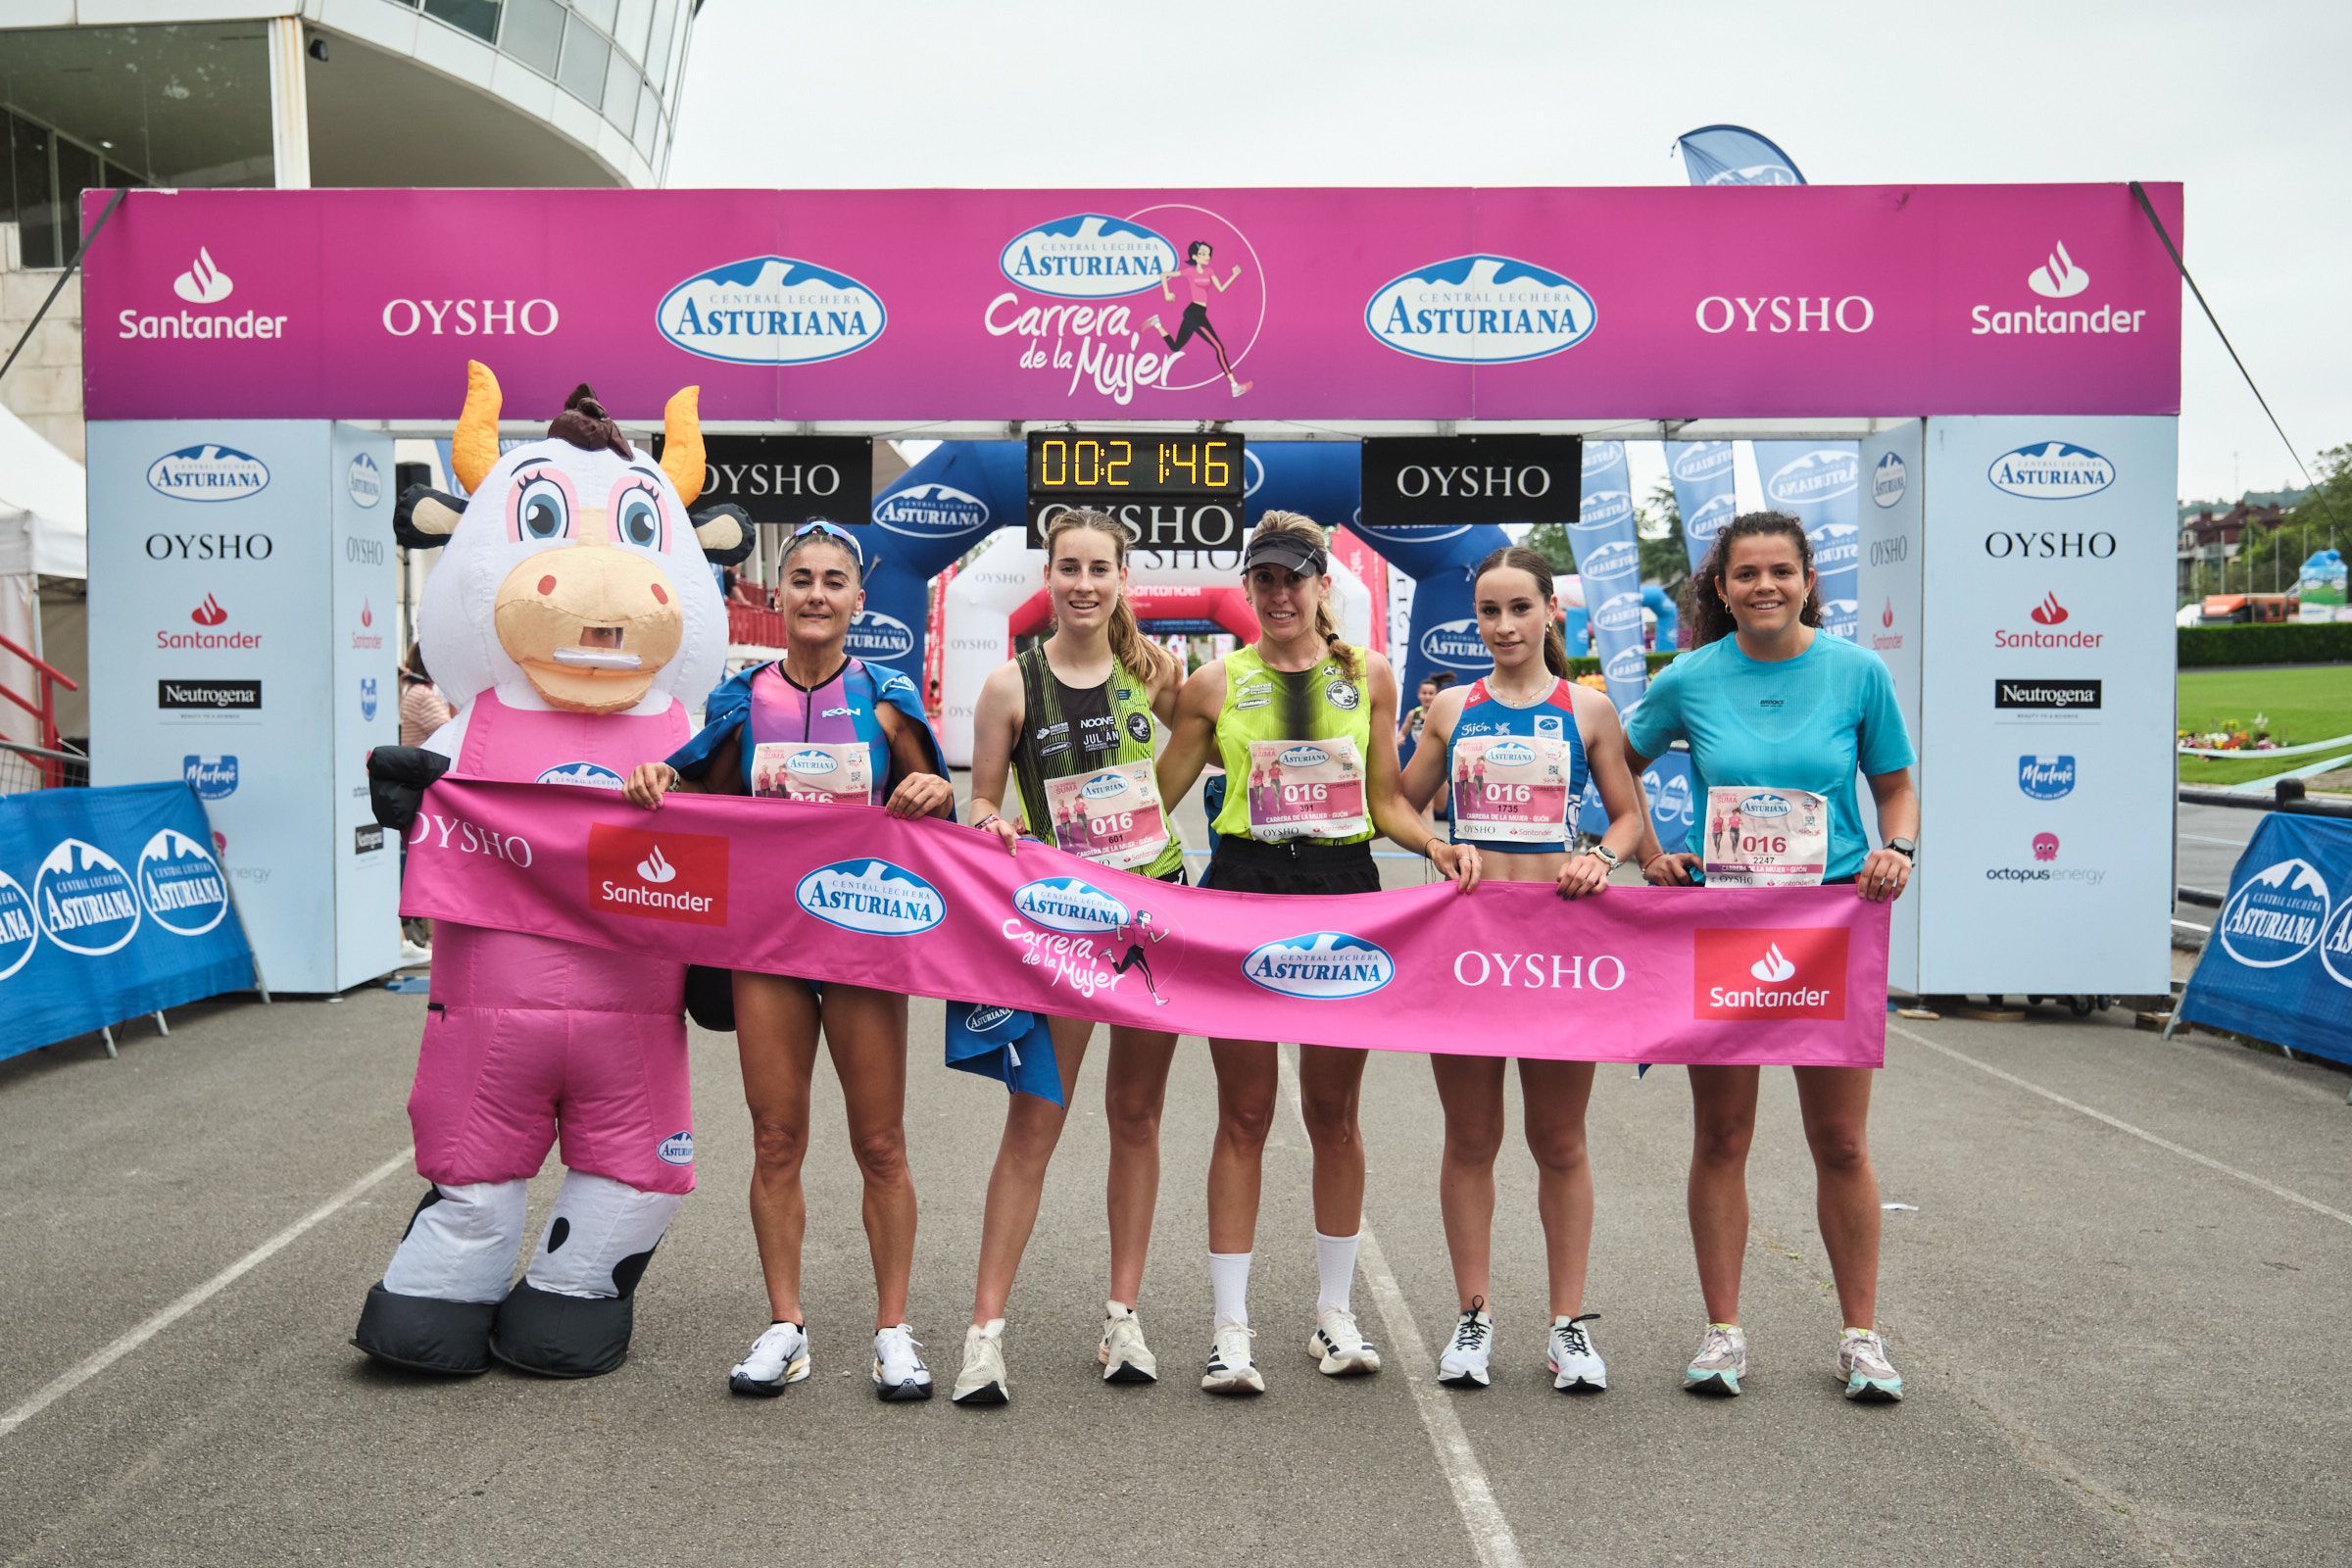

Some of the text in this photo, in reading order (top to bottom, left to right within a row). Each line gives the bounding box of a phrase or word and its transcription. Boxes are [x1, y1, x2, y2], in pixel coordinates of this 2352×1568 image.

[1042, 243, 1158, 252] CENTRAL LECHERA
[1014, 245, 1163, 276] ASTURIANA
[710, 295, 860, 305] CENTRAL LECHERA
[1419, 293, 1572, 303] CENTRAL LECHERA
[119, 309, 288, 340] Santander
[382, 298, 560, 336] OYSHO
[675, 297, 868, 336] ASTURIANA
[985, 293, 1132, 337] Carrera
[1384, 295, 1579, 334] ASTURIANA
[1695, 296, 1874, 334] OYSHO
[1971, 304, 2146, 335] Santander
[1020, 331, 1186, 405] de la Mujer
[157, 466, 262, 487] ASTURIANA
[1396, 465, 1551, 498] OYSHO
[1999, 464, 2105, 485] ASTURIANA
[880, 501, 979, 525] ASTURIANA
[146, 533, 272, 561] OYSHO
[347, 536, 384, 566] OYSHO
[1871, 535, 1907, 566] OYSHO
[1985, 531, 2117, 559] OYSHO
[975, 573, 1025, 584] OYSHO
[157, 630, 263, 650] Santander
[951, 639, 998, 651] OYSHO
[1994, 630, 2103, 649] Santander
[166, 685, 255, 707] Neutrogena
[2002, 684, 2094, 707] Neutrogena
[949, 708, 973, 717] OYS
[1080, 715, 1114, 729] NOONE
[1083, 729, 1119, 745] JULÁN
[1461, 722, 1491, 736] gijón
[791, 760, 834, 769] ASTURIANA
[1282, 755, 1326, 763] ASTURIANA
[1489, 750, 1533, 761] ASTURIANA
[1284, 783, 1327, 803] 016
[1486, 784, 1531, 802] 016
[1744, 803, 1788, 812] ASTURIANA
[1091, 811, 1133, 836] 016
[1263, 827, 1299, 838] OYSHO
[1464, 824, 1495, 833] OYSHO
[409, 810, 532, 869] OYSHO
[1108, 834, 1124, 844] 601
[1742, 836, 1787, 853] 016
[1986, 867, 2106, 884] octopus energy
[146, 871, 223, 913] ASTURIANA
[602, 880, 713, 912] Santander
[808, 880, 933, 922] ASTURIANA
[832, 880, 930, 900] CENTRAL LECHERA
[1041, 891, 1119, 909] CENTRAL LECHERA
[45, 886, 136, 933] ASTURIANA
[1021, 892, 1120, 925] ASTURIANA
[2226, 893, 2318, 946] ASTURIANA
[1003, 918, 1094, 959] Carrera
[1022, 946, 1125, 998] de la Mujer
[1252, 954, 1382, 982] ASTURIANA
[1453, 951, 1626, 991] OYSHO
[1709, 987, 1830, 1007] Santander
